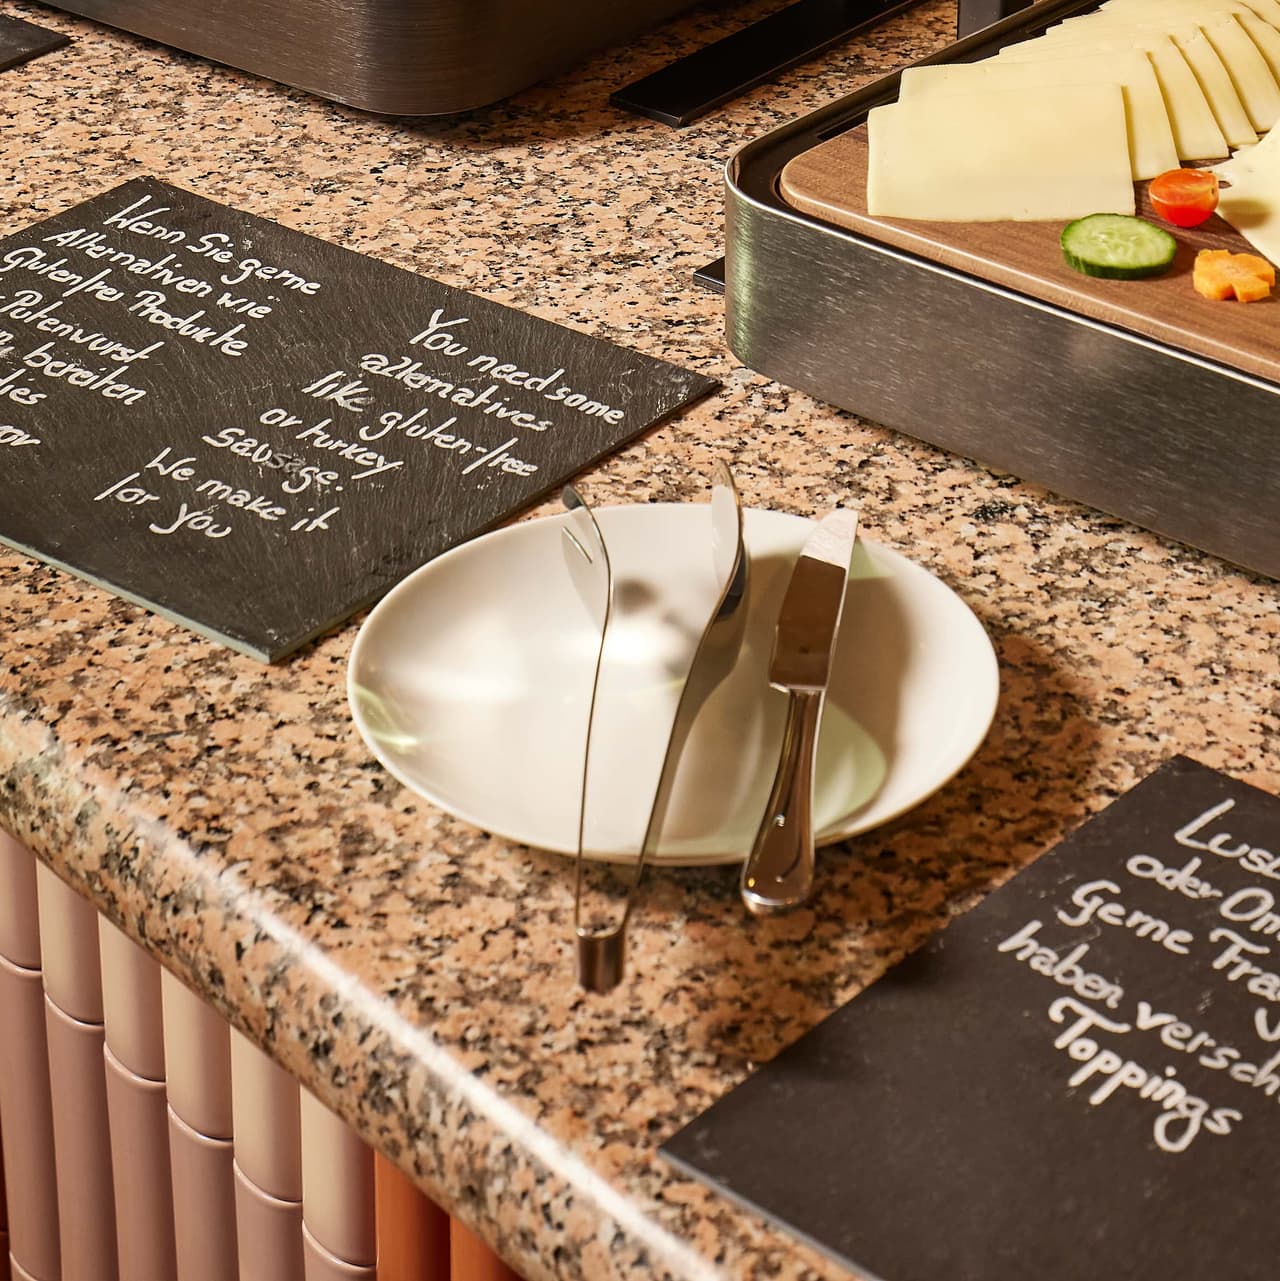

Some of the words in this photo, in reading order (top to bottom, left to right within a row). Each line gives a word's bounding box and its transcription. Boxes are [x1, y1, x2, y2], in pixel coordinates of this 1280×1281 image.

[43, 228, 213, 298] Alternativen
[217, 292, 274, 319] wie
[103, 195, 186, 244] Wenn
[186, 233, 234, 263] Sie
[221, 258, 320, 295] gerne
[0, 290, 165, 363] Putenwurst
[129, 290, 248, 357] Produkte
[22, 342, 147, 406] bereiten
[302, 371, 375, 413] like
[359, 352, 553, 432] alternatives
[409, 309, 469, 356] You
[467, 352, 567, 390] need
[544, 383, 626, 426] some
[259, 408, 303, 428] or
[296, 418, 404, 480] turkey
[94, 473, 160, 504] for
[149, 503, 232, 537] you
[145, 447, 197, 480] We
[196, 479, 287, 520] make
[290, 507, 340, 532] it
[1125, 854, 1222, 901] oder
[1057, 879, 1194, 954] Gerne
[998, 920, 1123, 1008] haben
[1048, 996, 1242, 1153] Toppings
